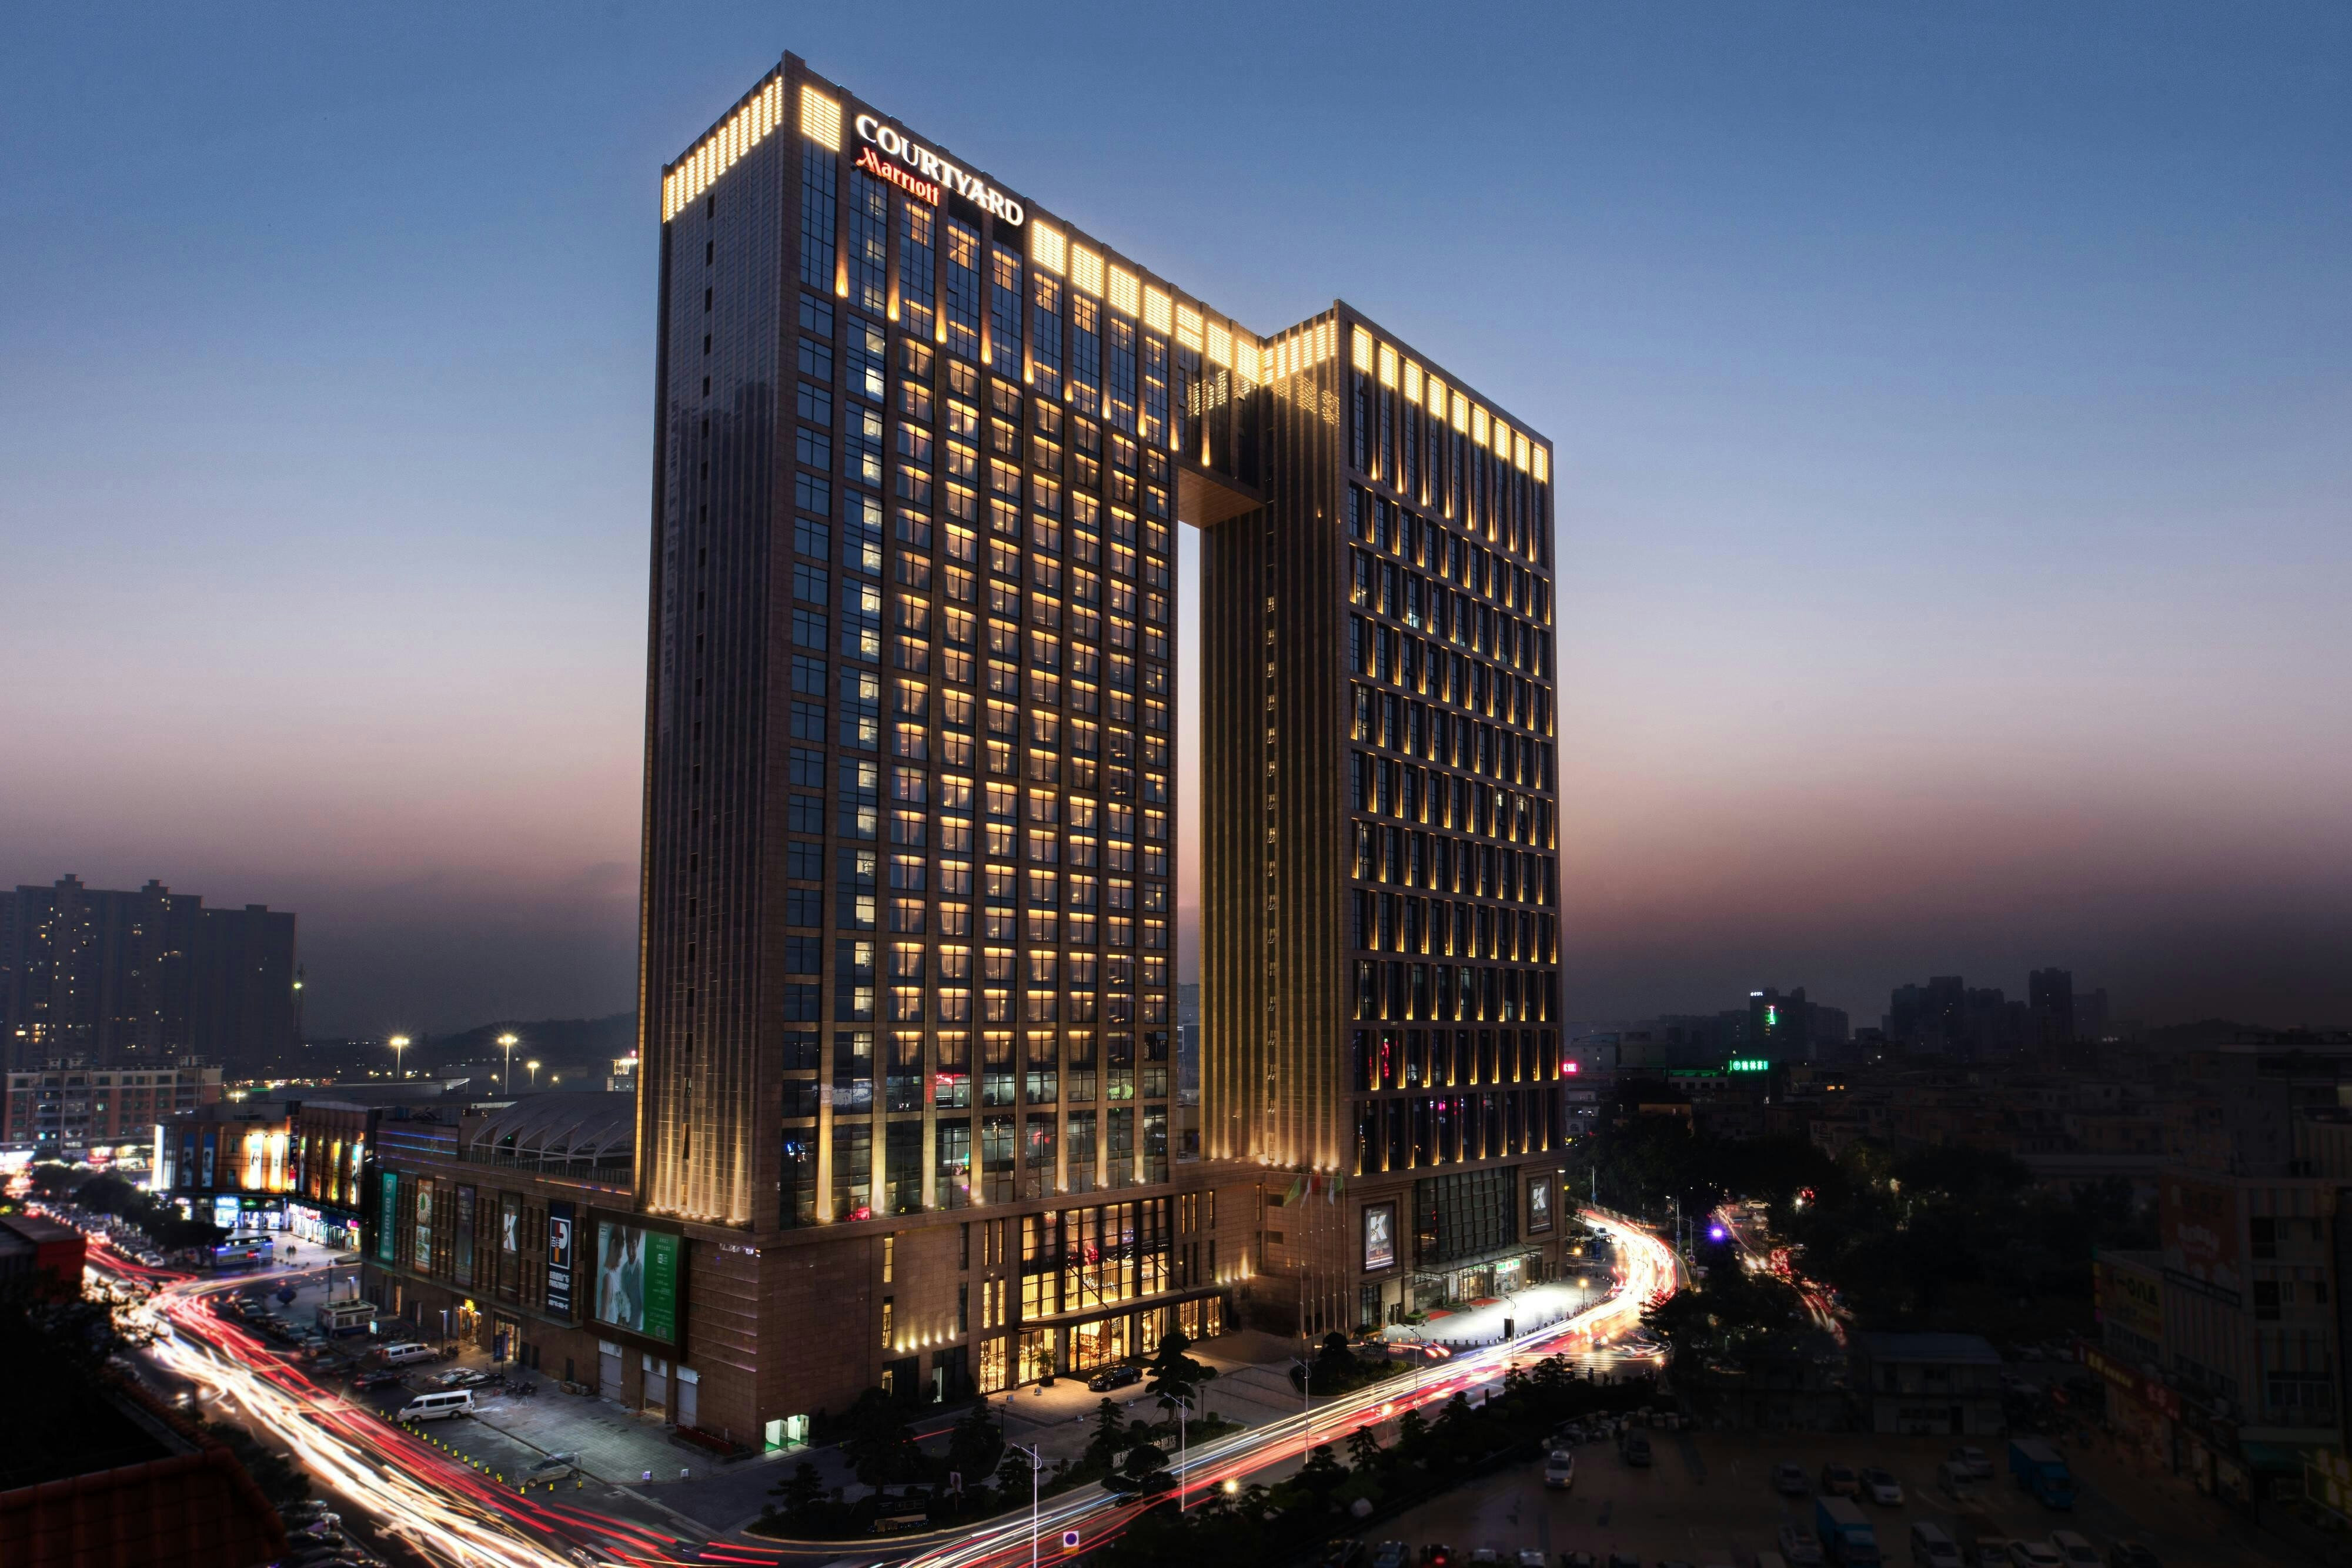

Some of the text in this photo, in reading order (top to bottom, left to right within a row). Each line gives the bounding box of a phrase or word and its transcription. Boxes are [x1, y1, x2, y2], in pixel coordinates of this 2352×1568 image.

[856, 115, 1024, 226] COURTYARD
[856, 147, 940, 206] Marriott
[1534, 1188, 1546, 1209] K
[503, 1213, 517, 1251] K
[1371, 1215, 1387, 1241] K
